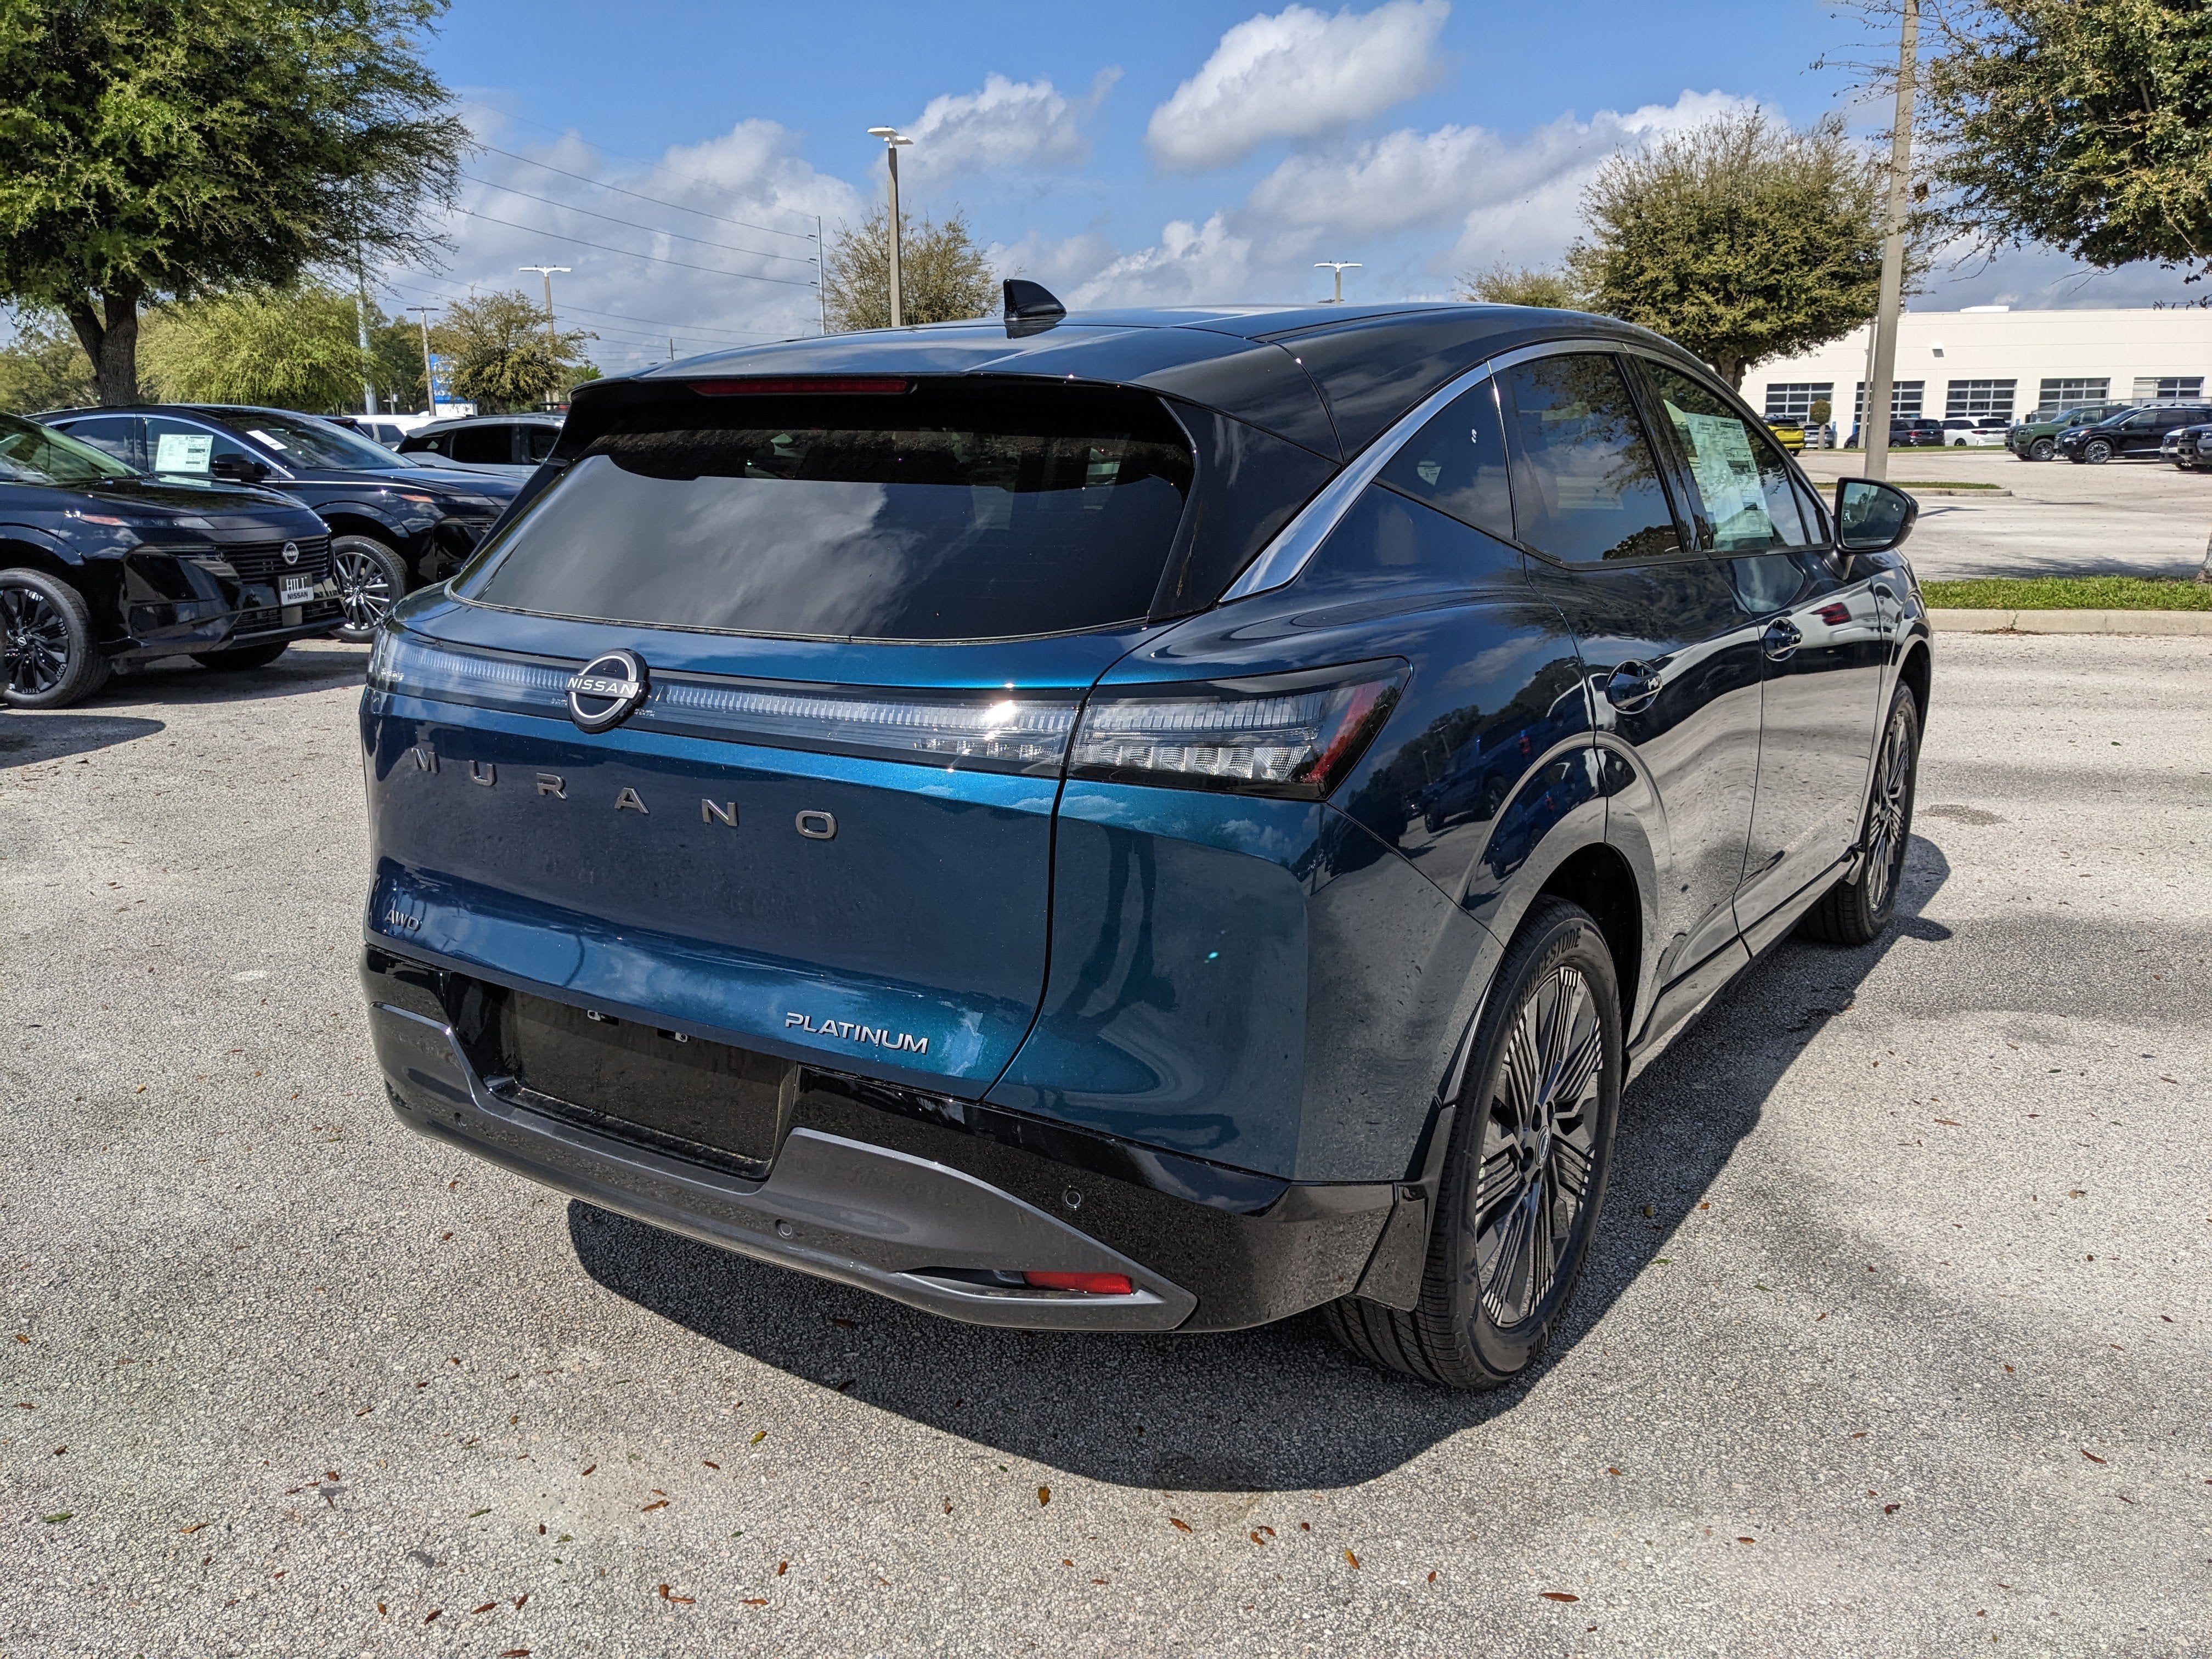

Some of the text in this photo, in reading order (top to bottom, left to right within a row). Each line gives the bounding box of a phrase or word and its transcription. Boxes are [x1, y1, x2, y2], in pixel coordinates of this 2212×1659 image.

[287, 592, 308, 600] NISSAN
[567, 678, 638, 695] NISSAN
[410, 747, 837, 839] MURANO
[385, 910, 420, 931] AWD
[785, 1012, 929, 1054] PLATINUM
